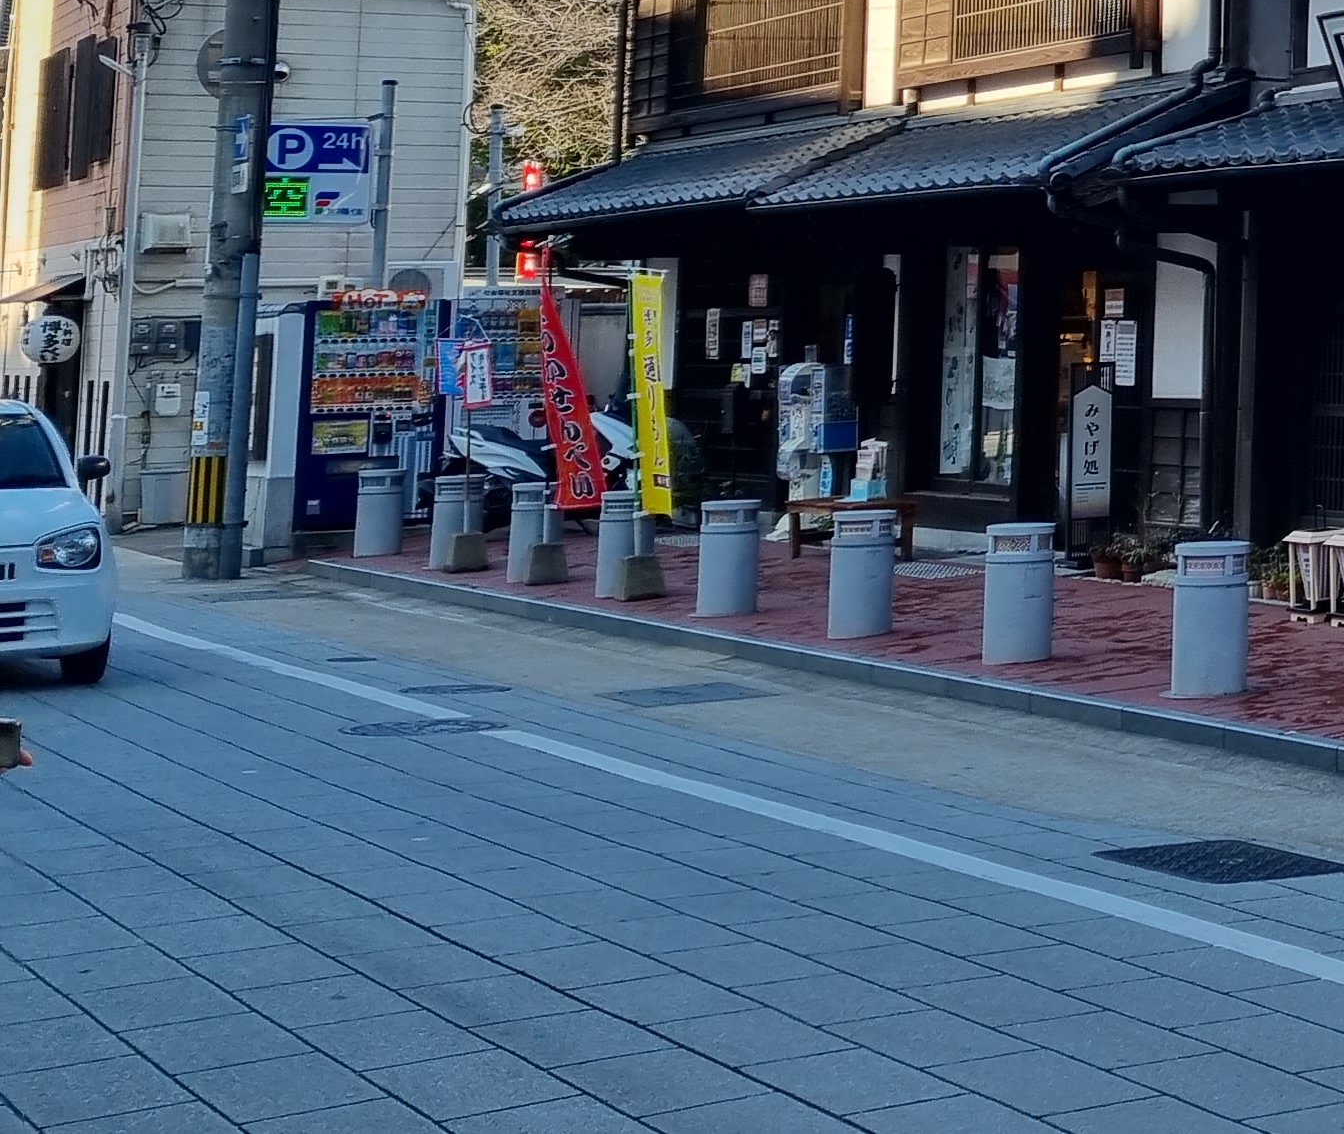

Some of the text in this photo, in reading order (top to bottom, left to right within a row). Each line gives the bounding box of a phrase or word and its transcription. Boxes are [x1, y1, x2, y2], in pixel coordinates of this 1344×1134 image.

[277, 132, 365, 165] P 24h
[264, 177, 308, 217] 空
[1082, 403, 1100, 476] みやげ処
